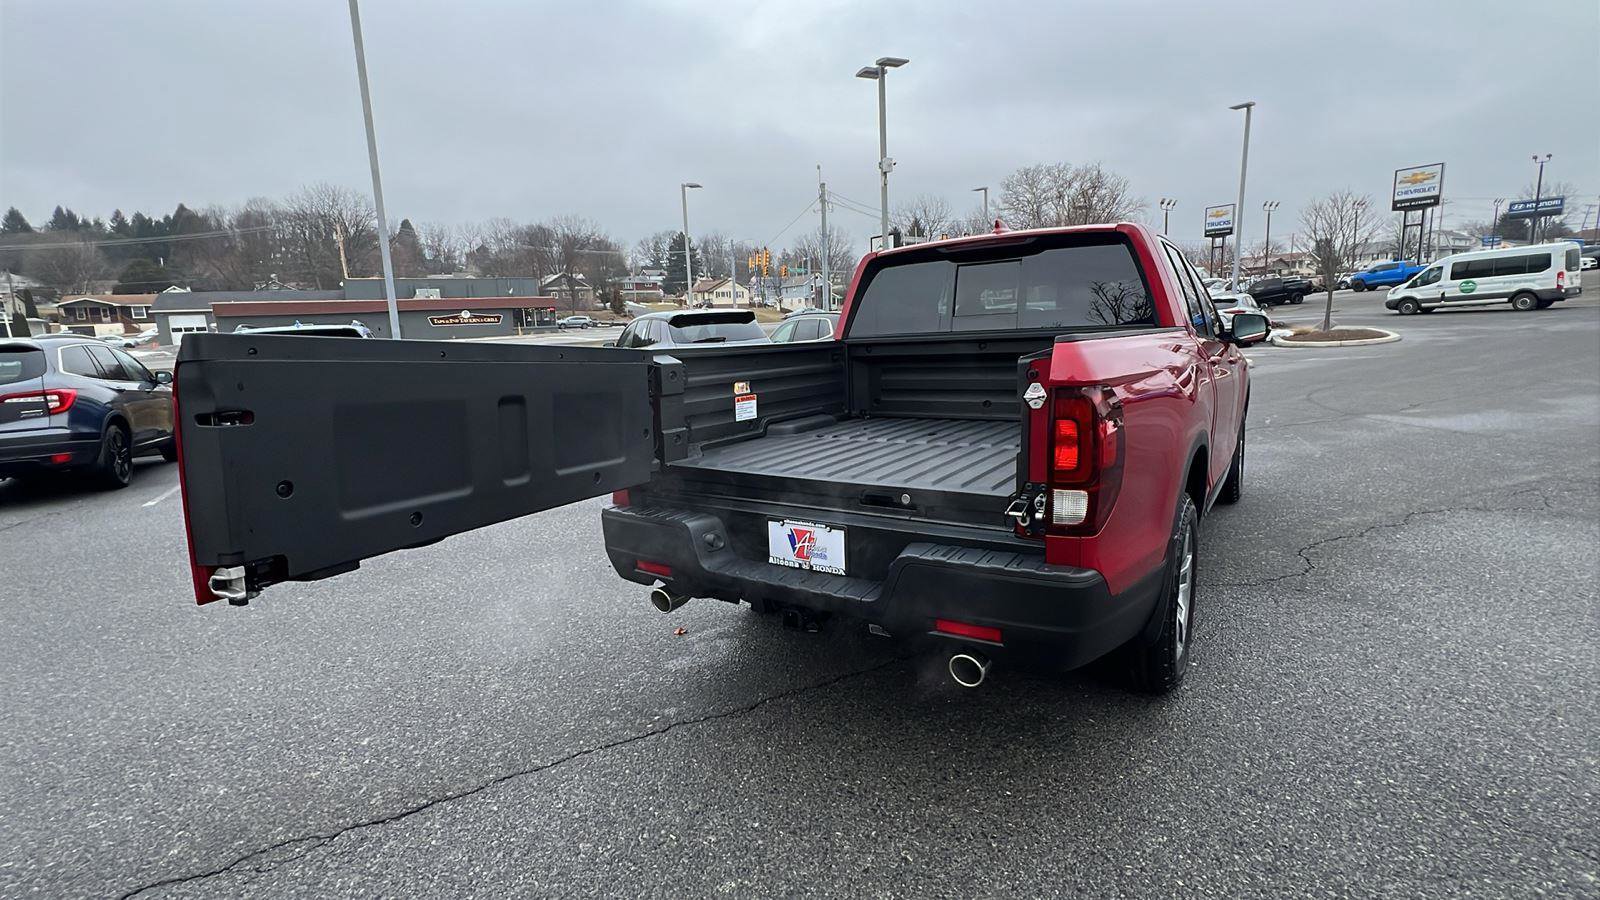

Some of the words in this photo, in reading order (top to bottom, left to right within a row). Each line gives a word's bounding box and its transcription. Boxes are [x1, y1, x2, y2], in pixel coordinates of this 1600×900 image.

[1397, 186, 1436, 196] CHEVROLET
[1526, 200, 1561, 208] HYUNDAI
[769, 556, 800, 568] Altoona
[813, 564, 846, 576] HONDA
